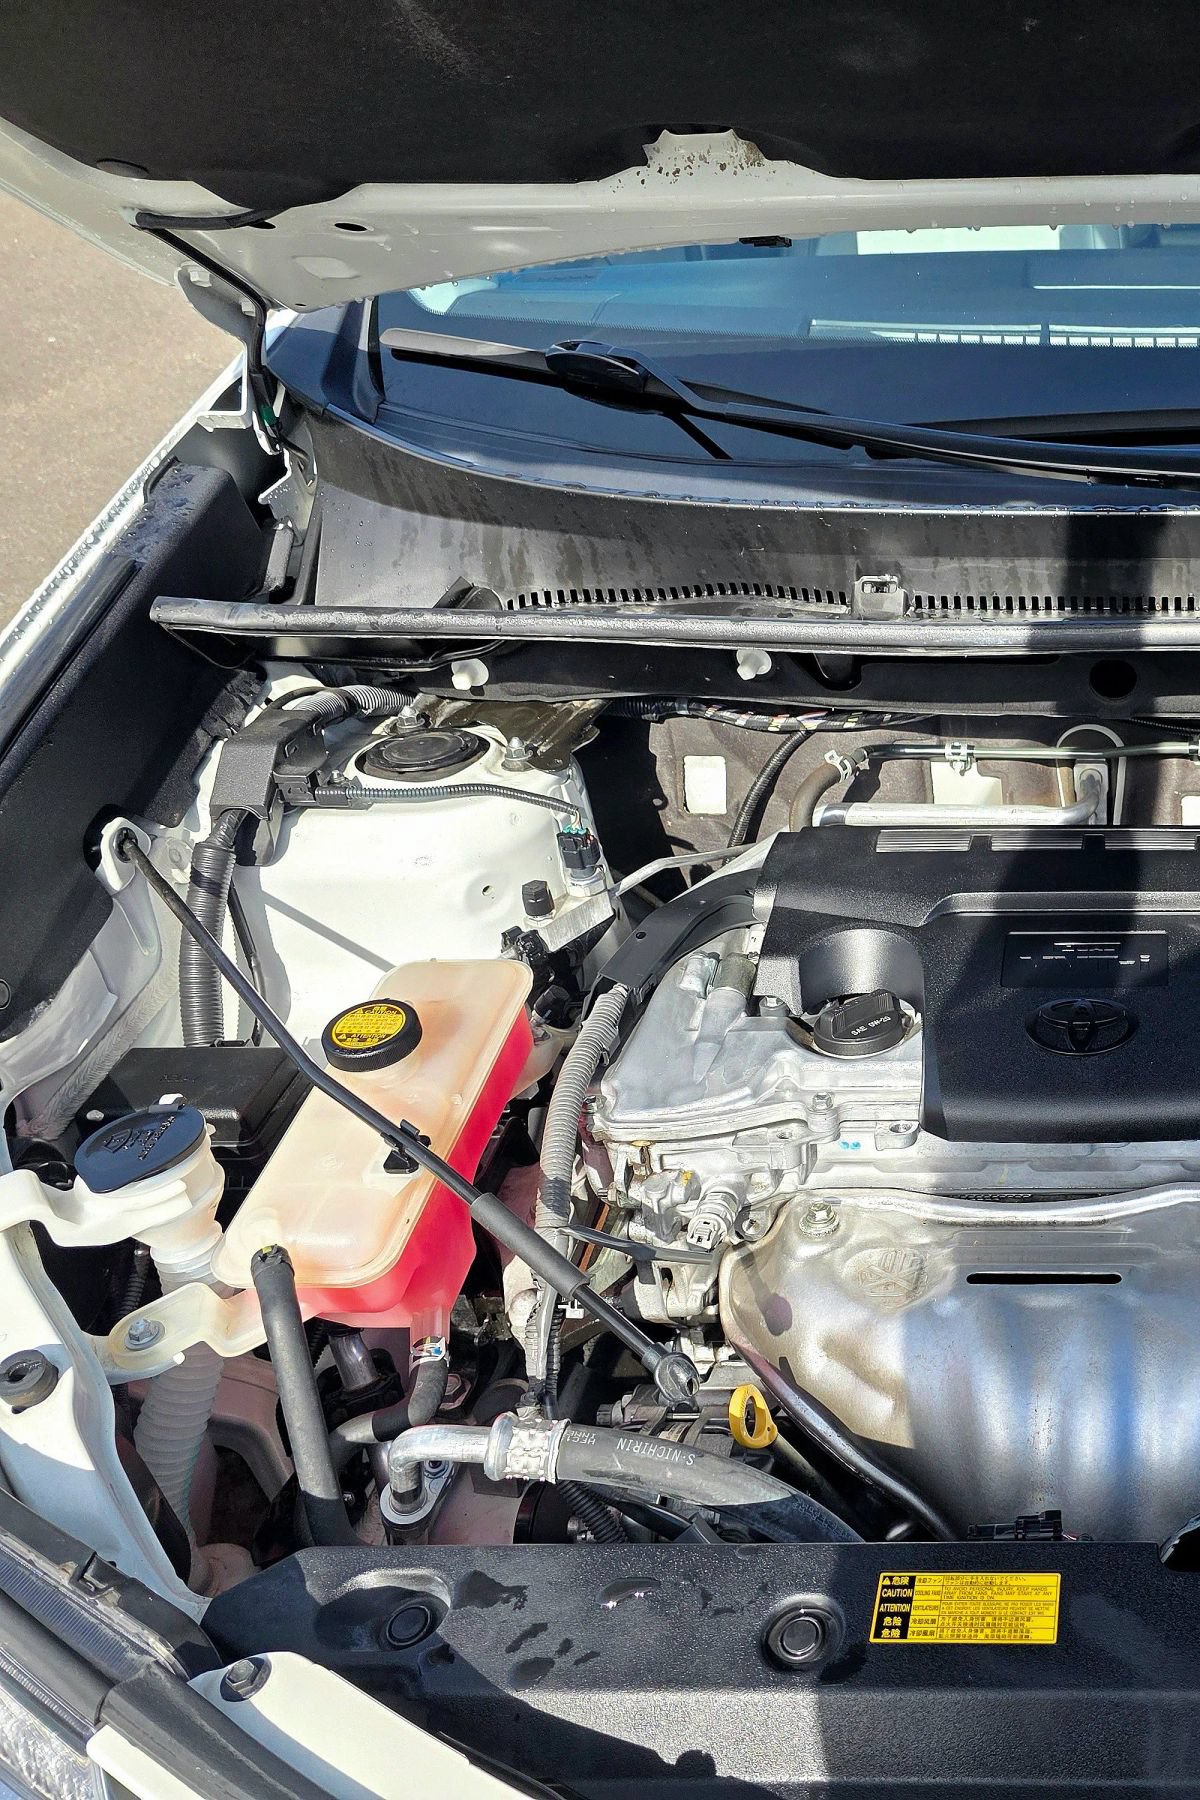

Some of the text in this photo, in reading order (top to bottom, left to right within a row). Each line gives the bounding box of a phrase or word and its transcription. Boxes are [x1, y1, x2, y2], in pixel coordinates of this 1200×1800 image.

[850, 1026, 868, 1036] SAE
[882, 1589, 913, 1597] CAUTION
[880, 1604, 910, 1612] ATTENTION
